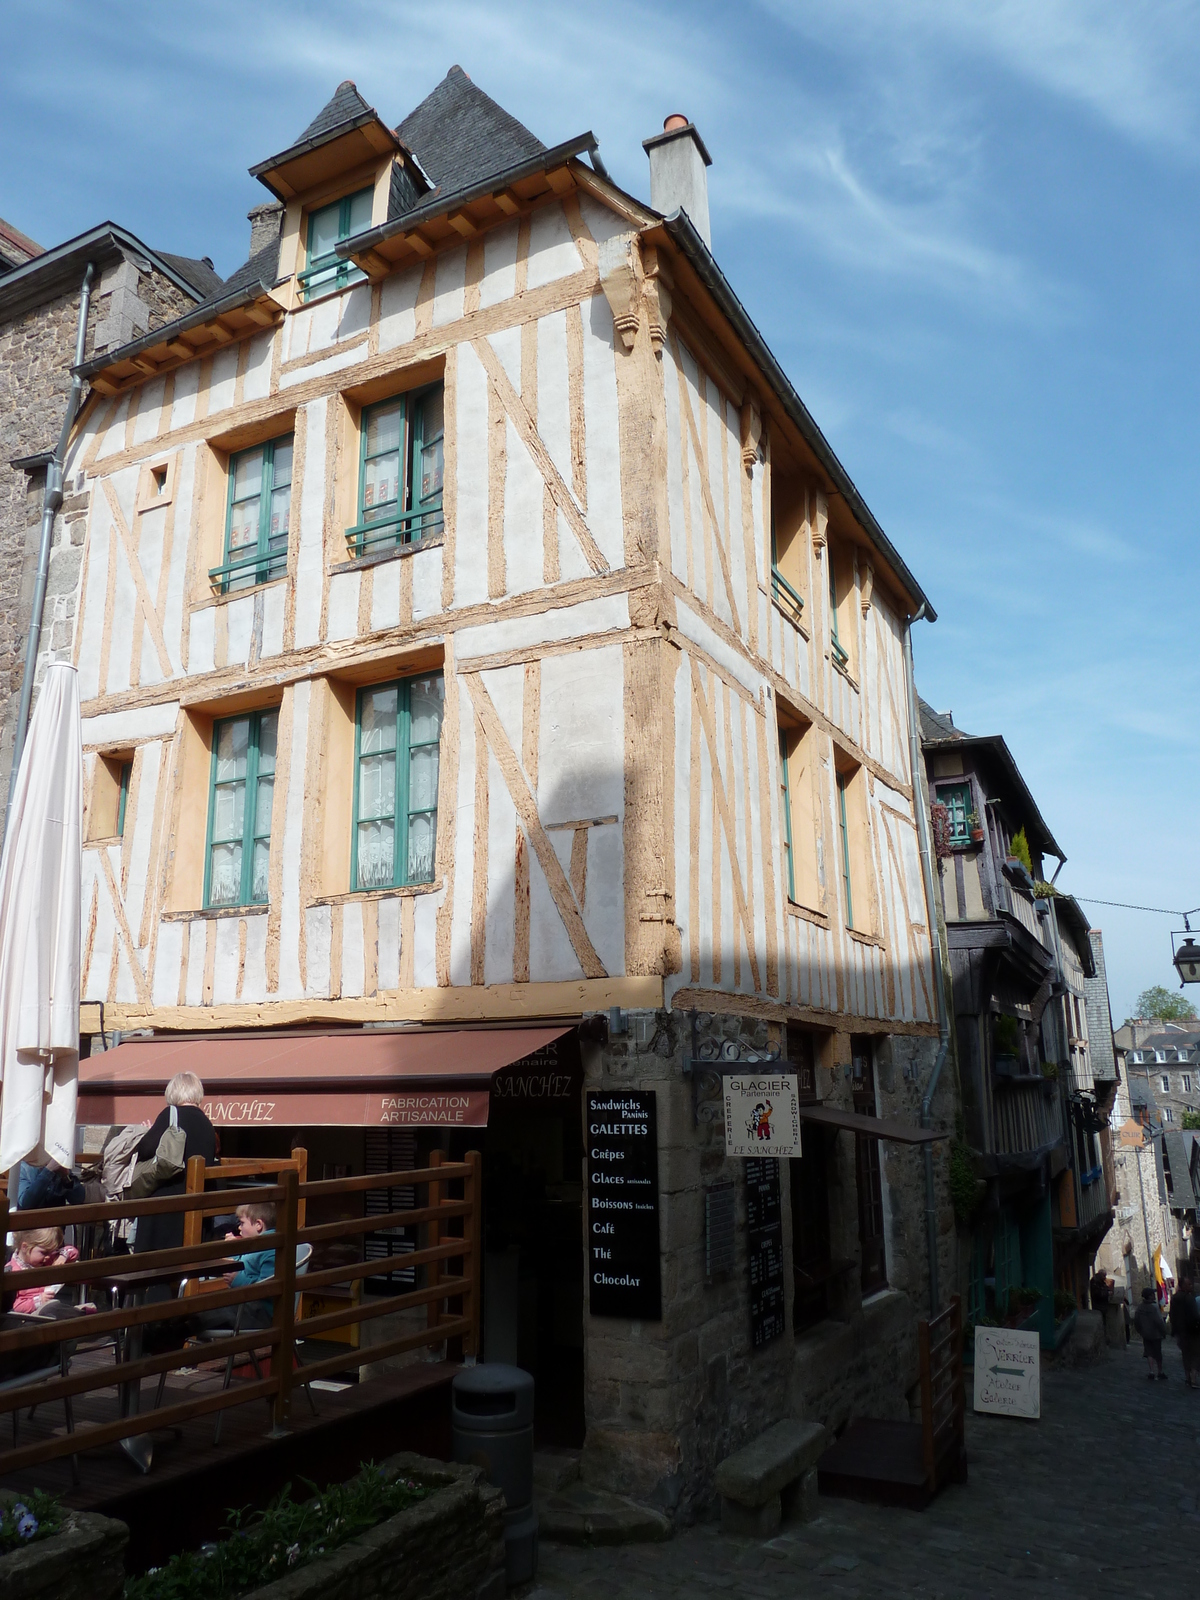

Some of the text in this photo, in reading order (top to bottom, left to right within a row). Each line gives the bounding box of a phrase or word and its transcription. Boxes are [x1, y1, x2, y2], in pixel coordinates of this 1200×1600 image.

[513, 1058, 558, 1066] enaire
[494, 1072, 572, 1098] SANCHEZ
[730, 1081, 791, 1091] GLACIER
[381, 1097, 470, 1109] FABRICATION
[202, 1100, 276, 1120] ANCHEZ
[380, 1110, 464, 1122] ARTISANALE
[790, 1094, 799, 1145] SANDWICHERIE
[590, 1124, 648, 1135] GALETTES
[734, 1145, 794, 1155] LE SANCHEZ
